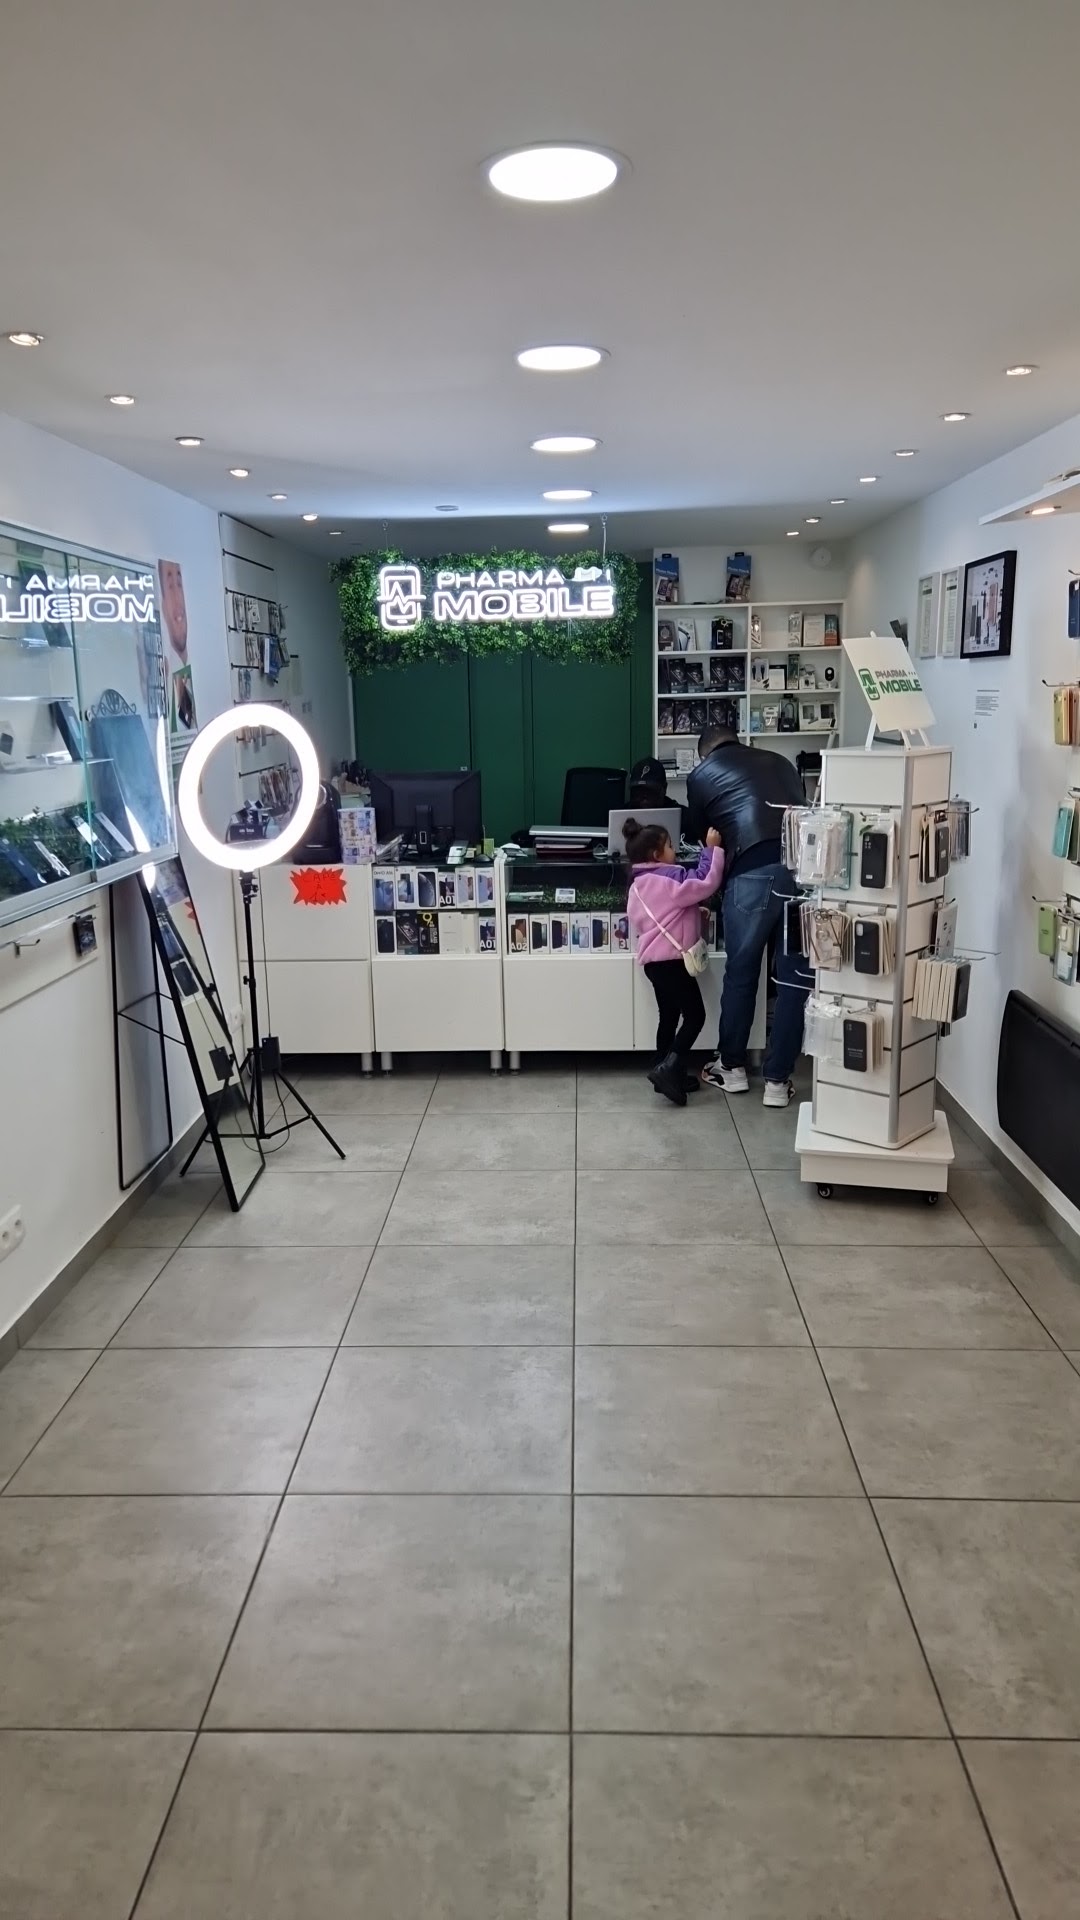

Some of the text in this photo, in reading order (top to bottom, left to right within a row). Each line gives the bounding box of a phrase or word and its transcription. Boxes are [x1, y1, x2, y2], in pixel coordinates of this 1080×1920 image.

[436, 569, 565, 589] PHARMA
[433, 585, 615, 621] MOBILE
[875, 669, 908, 679] PHARMA
[879, 679, 923, 694] MOBILE
